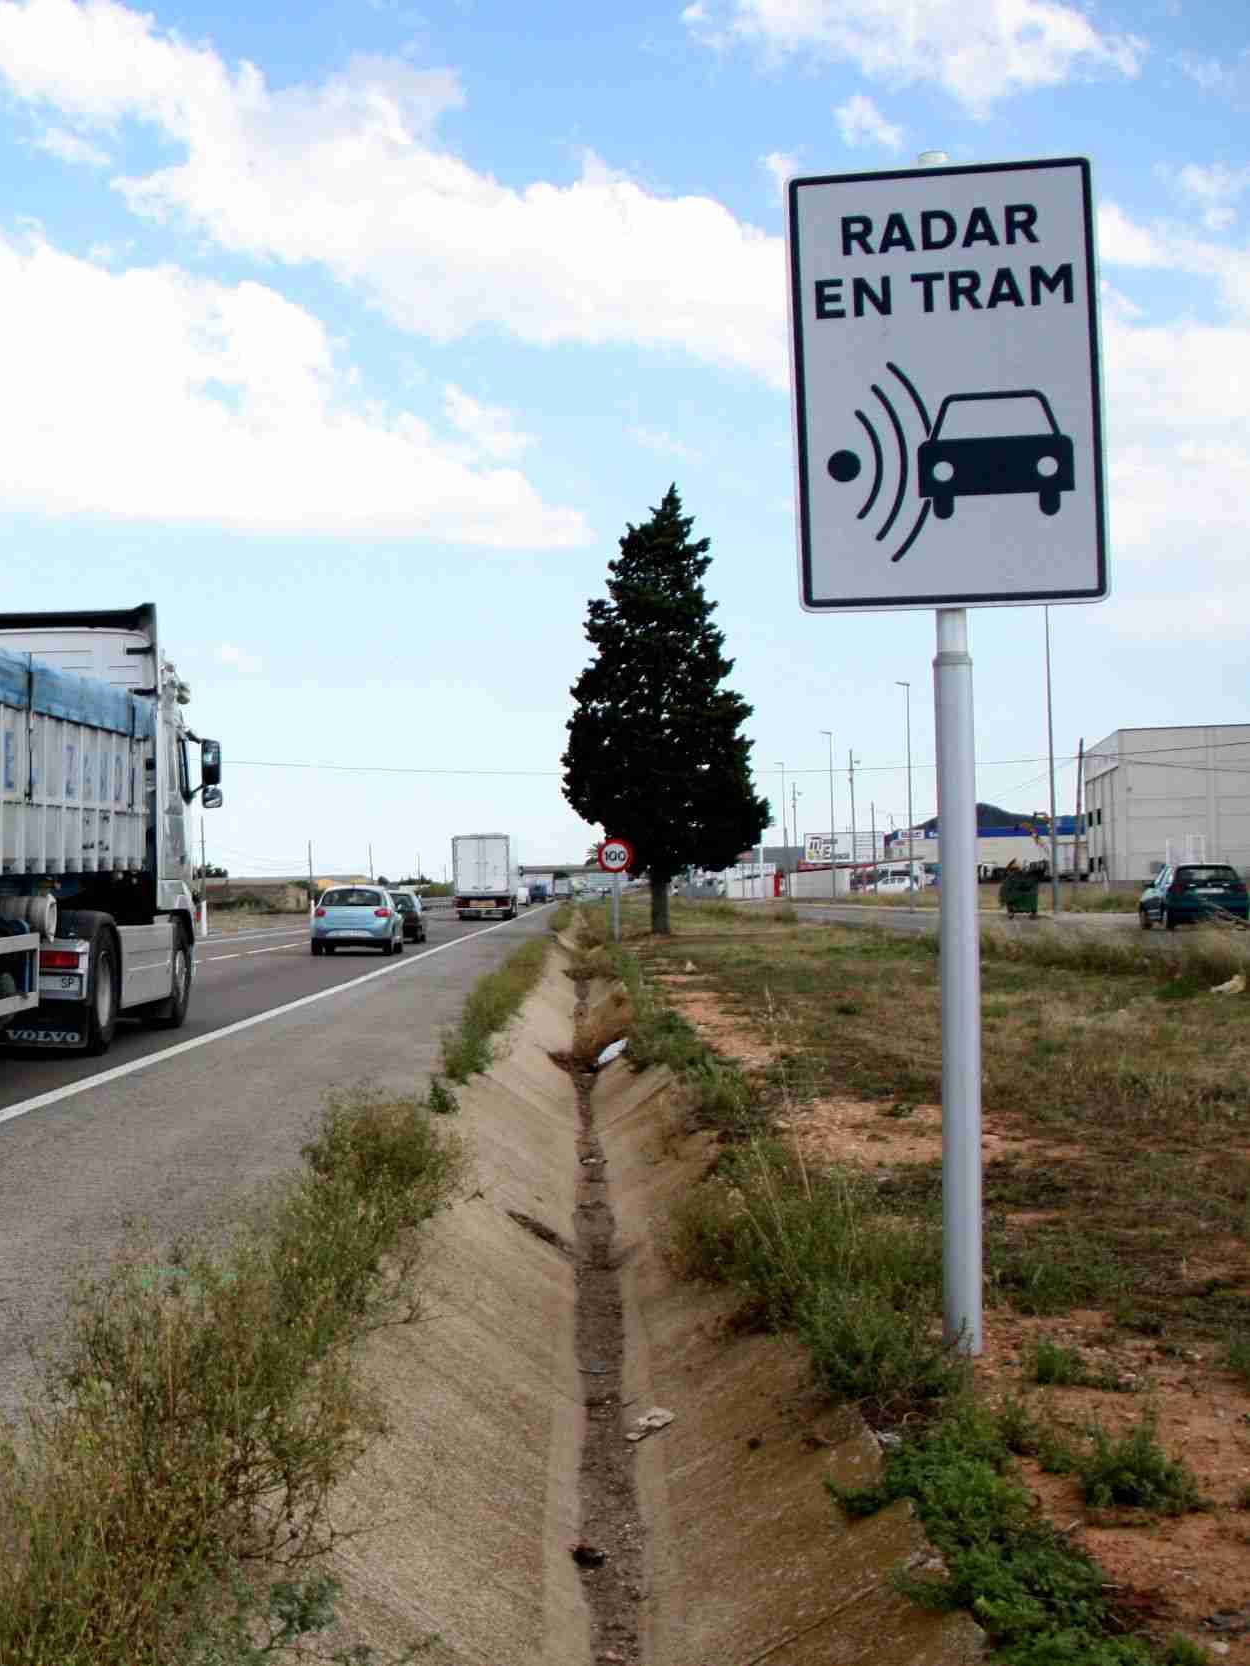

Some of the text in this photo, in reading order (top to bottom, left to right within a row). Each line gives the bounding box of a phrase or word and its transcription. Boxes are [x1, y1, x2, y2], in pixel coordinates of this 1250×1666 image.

[840, 203, 1040, 257] RADAR
[814, 262, 1076, 321] EN TRAM
[604, 850, 627, 863] 100
[62, 978, 74, 989] SP
[6, 1030, 80, 1042] VOLVO
